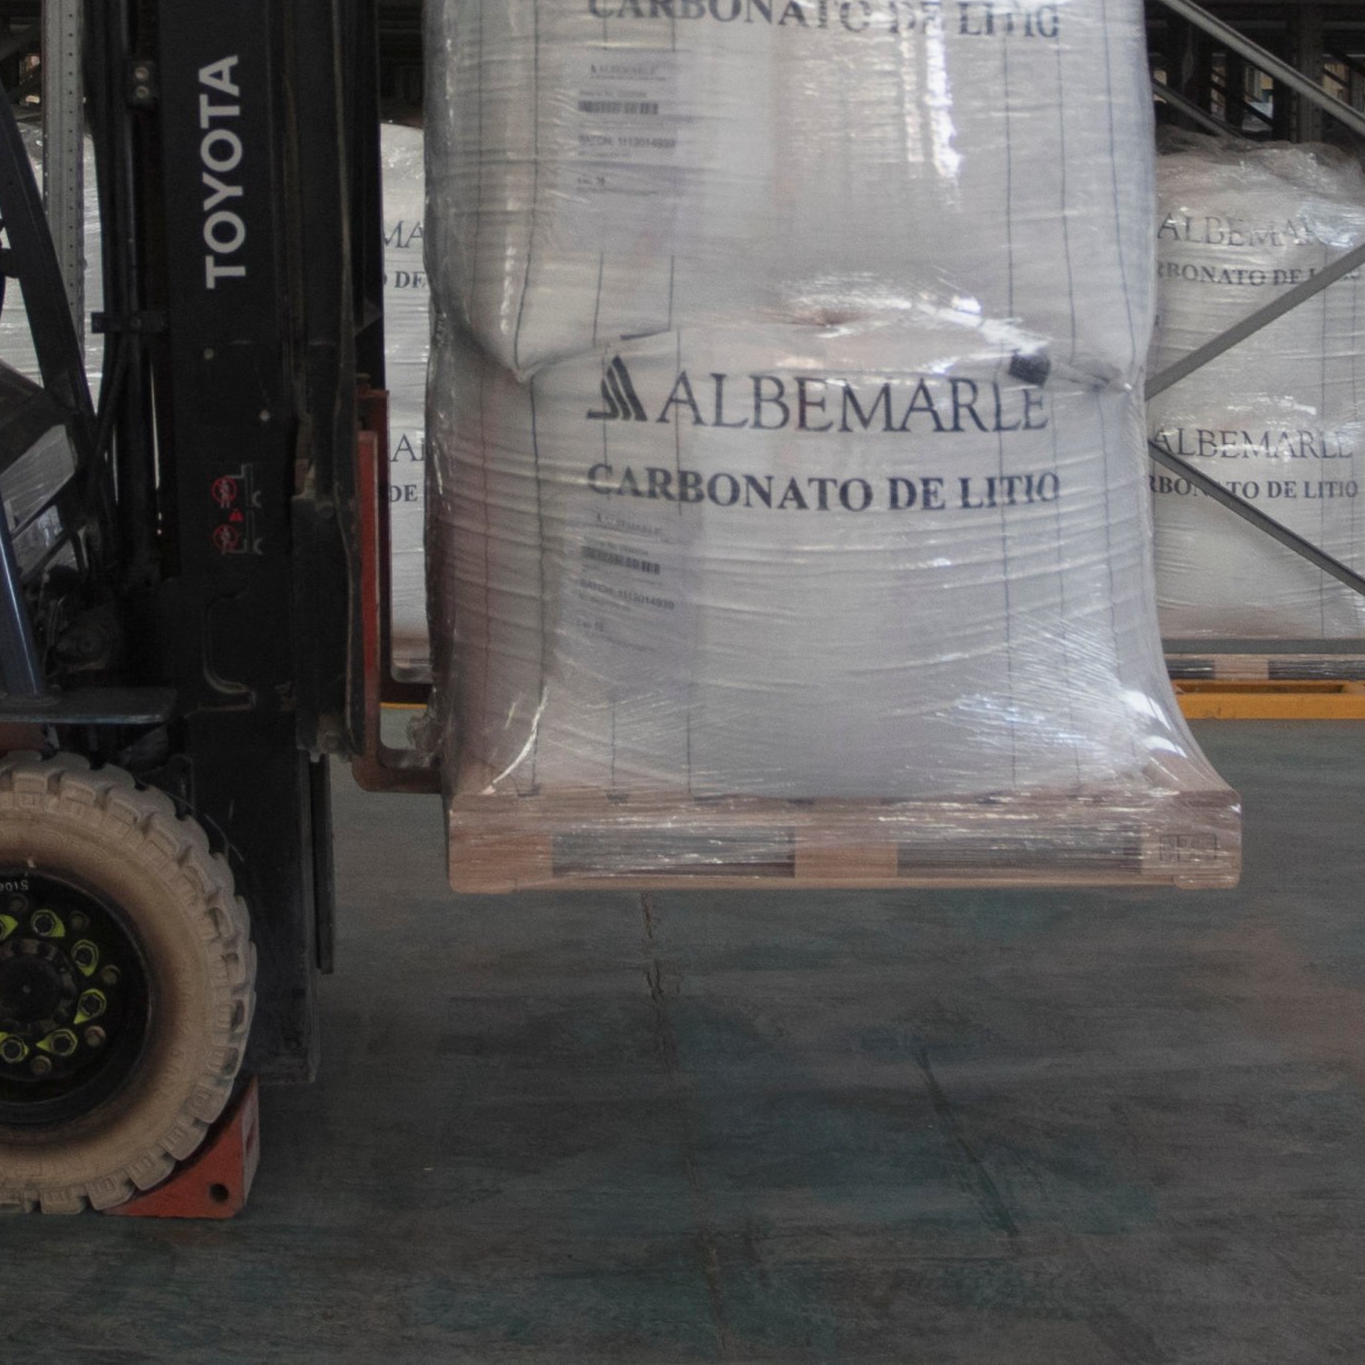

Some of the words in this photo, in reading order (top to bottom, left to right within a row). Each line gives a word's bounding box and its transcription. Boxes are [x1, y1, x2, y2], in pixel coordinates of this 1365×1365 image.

[888, 0, 942, 35] DE
[957, 1, 1061, 40] LITIO
[199, 55, 246, 289] TOYOTA
[1157, 211, 1318, 247] ALBEMA
[394, 271, 425, 290] DE
[1157, 262, 1267, 286] BONATO
[1273, 267, 1302, 285] DE
[656, 369, 1050, 434] ALBEMARLE
[1152, 428, 1356, 459] ALBEMARLE
[390, 484, 419, 503] DE
[587, 463, 886, 513] CARBONATO
[888, 476, 945, 512] DE
[960, 471, 1060, 508] LITIO
[1266, 480, 1298, 499] DE
[1303, 480, 1360, 499] LITIO
